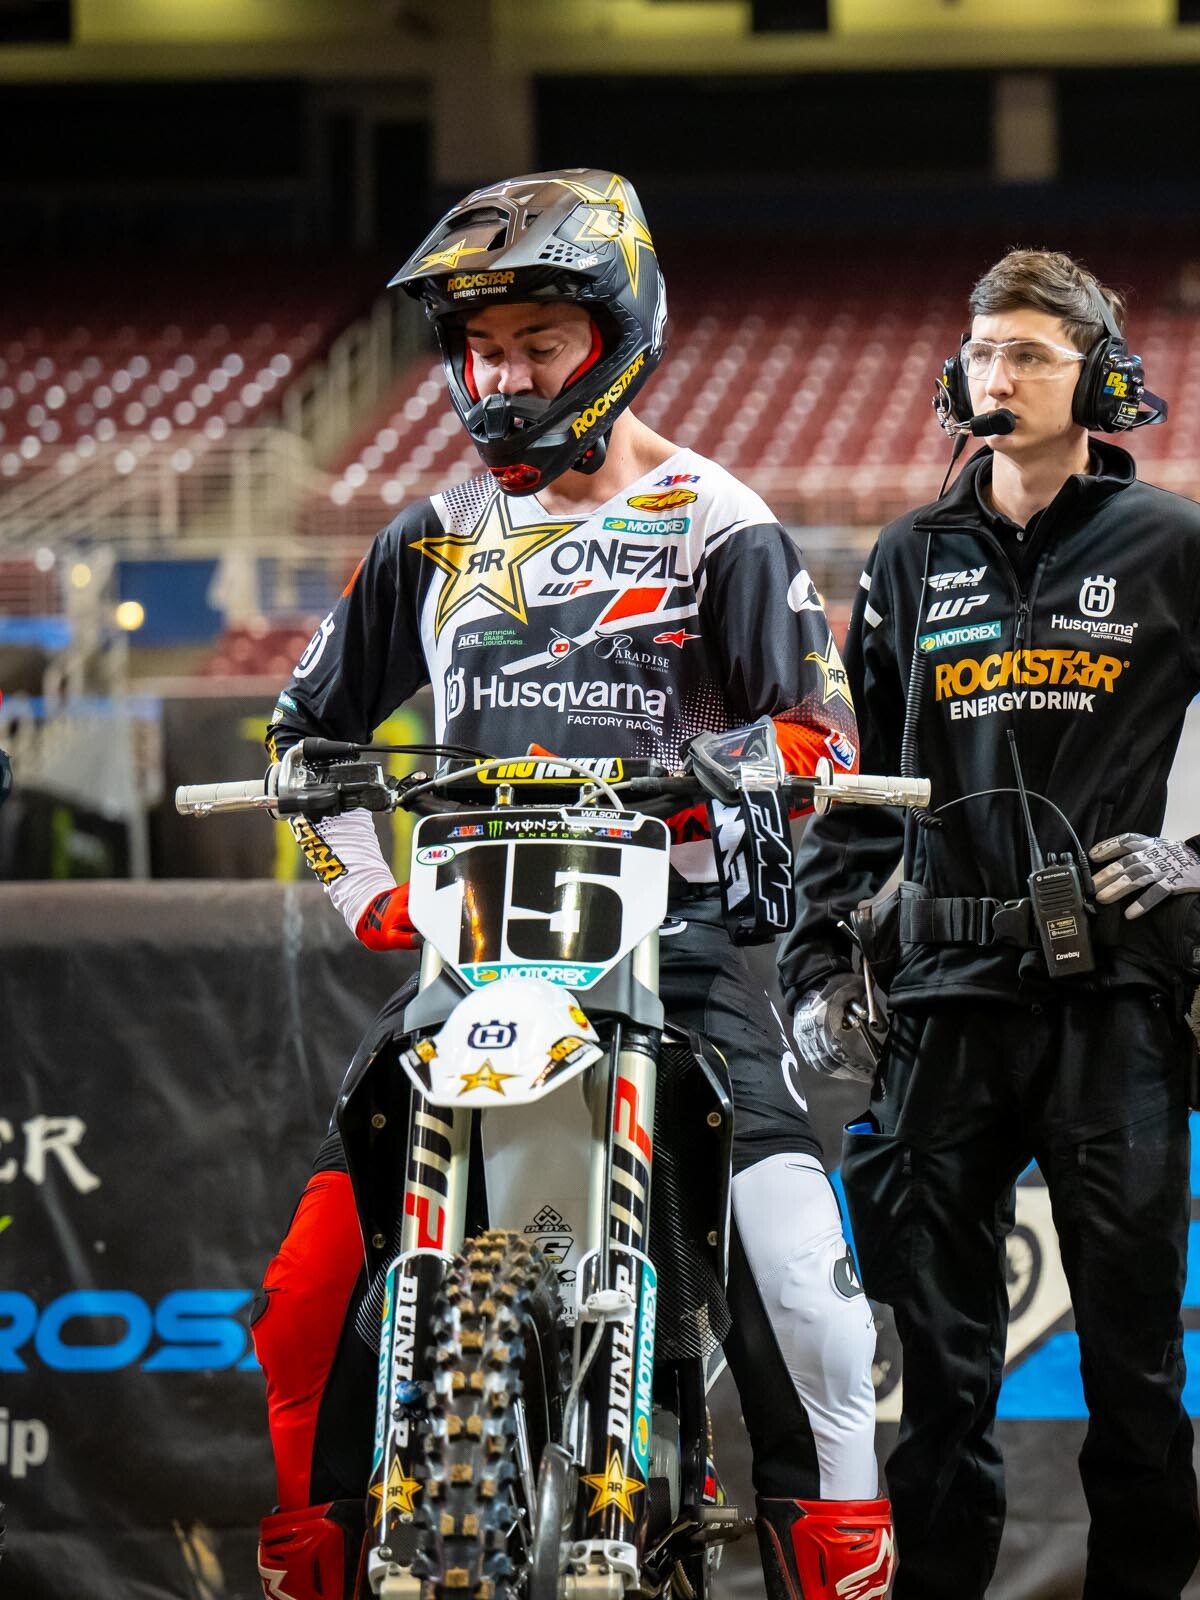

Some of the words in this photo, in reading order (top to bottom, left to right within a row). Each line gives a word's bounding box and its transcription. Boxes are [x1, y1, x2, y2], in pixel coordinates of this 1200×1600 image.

[447, 271, 515, 292] ROCKSTAR
[453, 288, 481, 299] ENERGY
[482, 285, 508, 295] DRINK
[571, 353, 645, 440] ROCKSTAR
[550, 538, 689, 583] O'NEAL
[922, 566, 988, 589] FLY
[936, 582, 979, 592] RACING
[538, 580, 592, 598] WP
[926, 594, 990, 623] WP
[484, 629, 516, 637] ARTIFICIAL
[935, 625, 997, 647] MOTOREX
[1051, 615, 1134, 637] Husqvarna
[457, 634, 483, 648] AGL
[594, 629, 670, 668] PARADISE
[1091, 633, 1113, 641] FACTORY
[1114, 636, 1133, 644] RACING
[935, 649, 1123, 701] ROCKSTAR
[473, 674, 666, 717] Husqvarna
[950, 691, 1028, 720] ENERGY
[1029, 690, 1096, 713] DRINK
[567, 715, 623, 728] FACTORY
[625, 719, 663, 736] RACING
[580, 810, 621, 820] WILSON
[436, 842, 624, 964] 15
[1056, 947, 1080, 961] Cowboy
[501, 967, 588, 984] MOTOREX
[0, 1289, 262, 1371] ROS
[607, 1264, 636, 1446] DUNLP
[636, 1274, 656, 1417] MOTOREX
[391, 1274, 419, 1448] DUNLP
